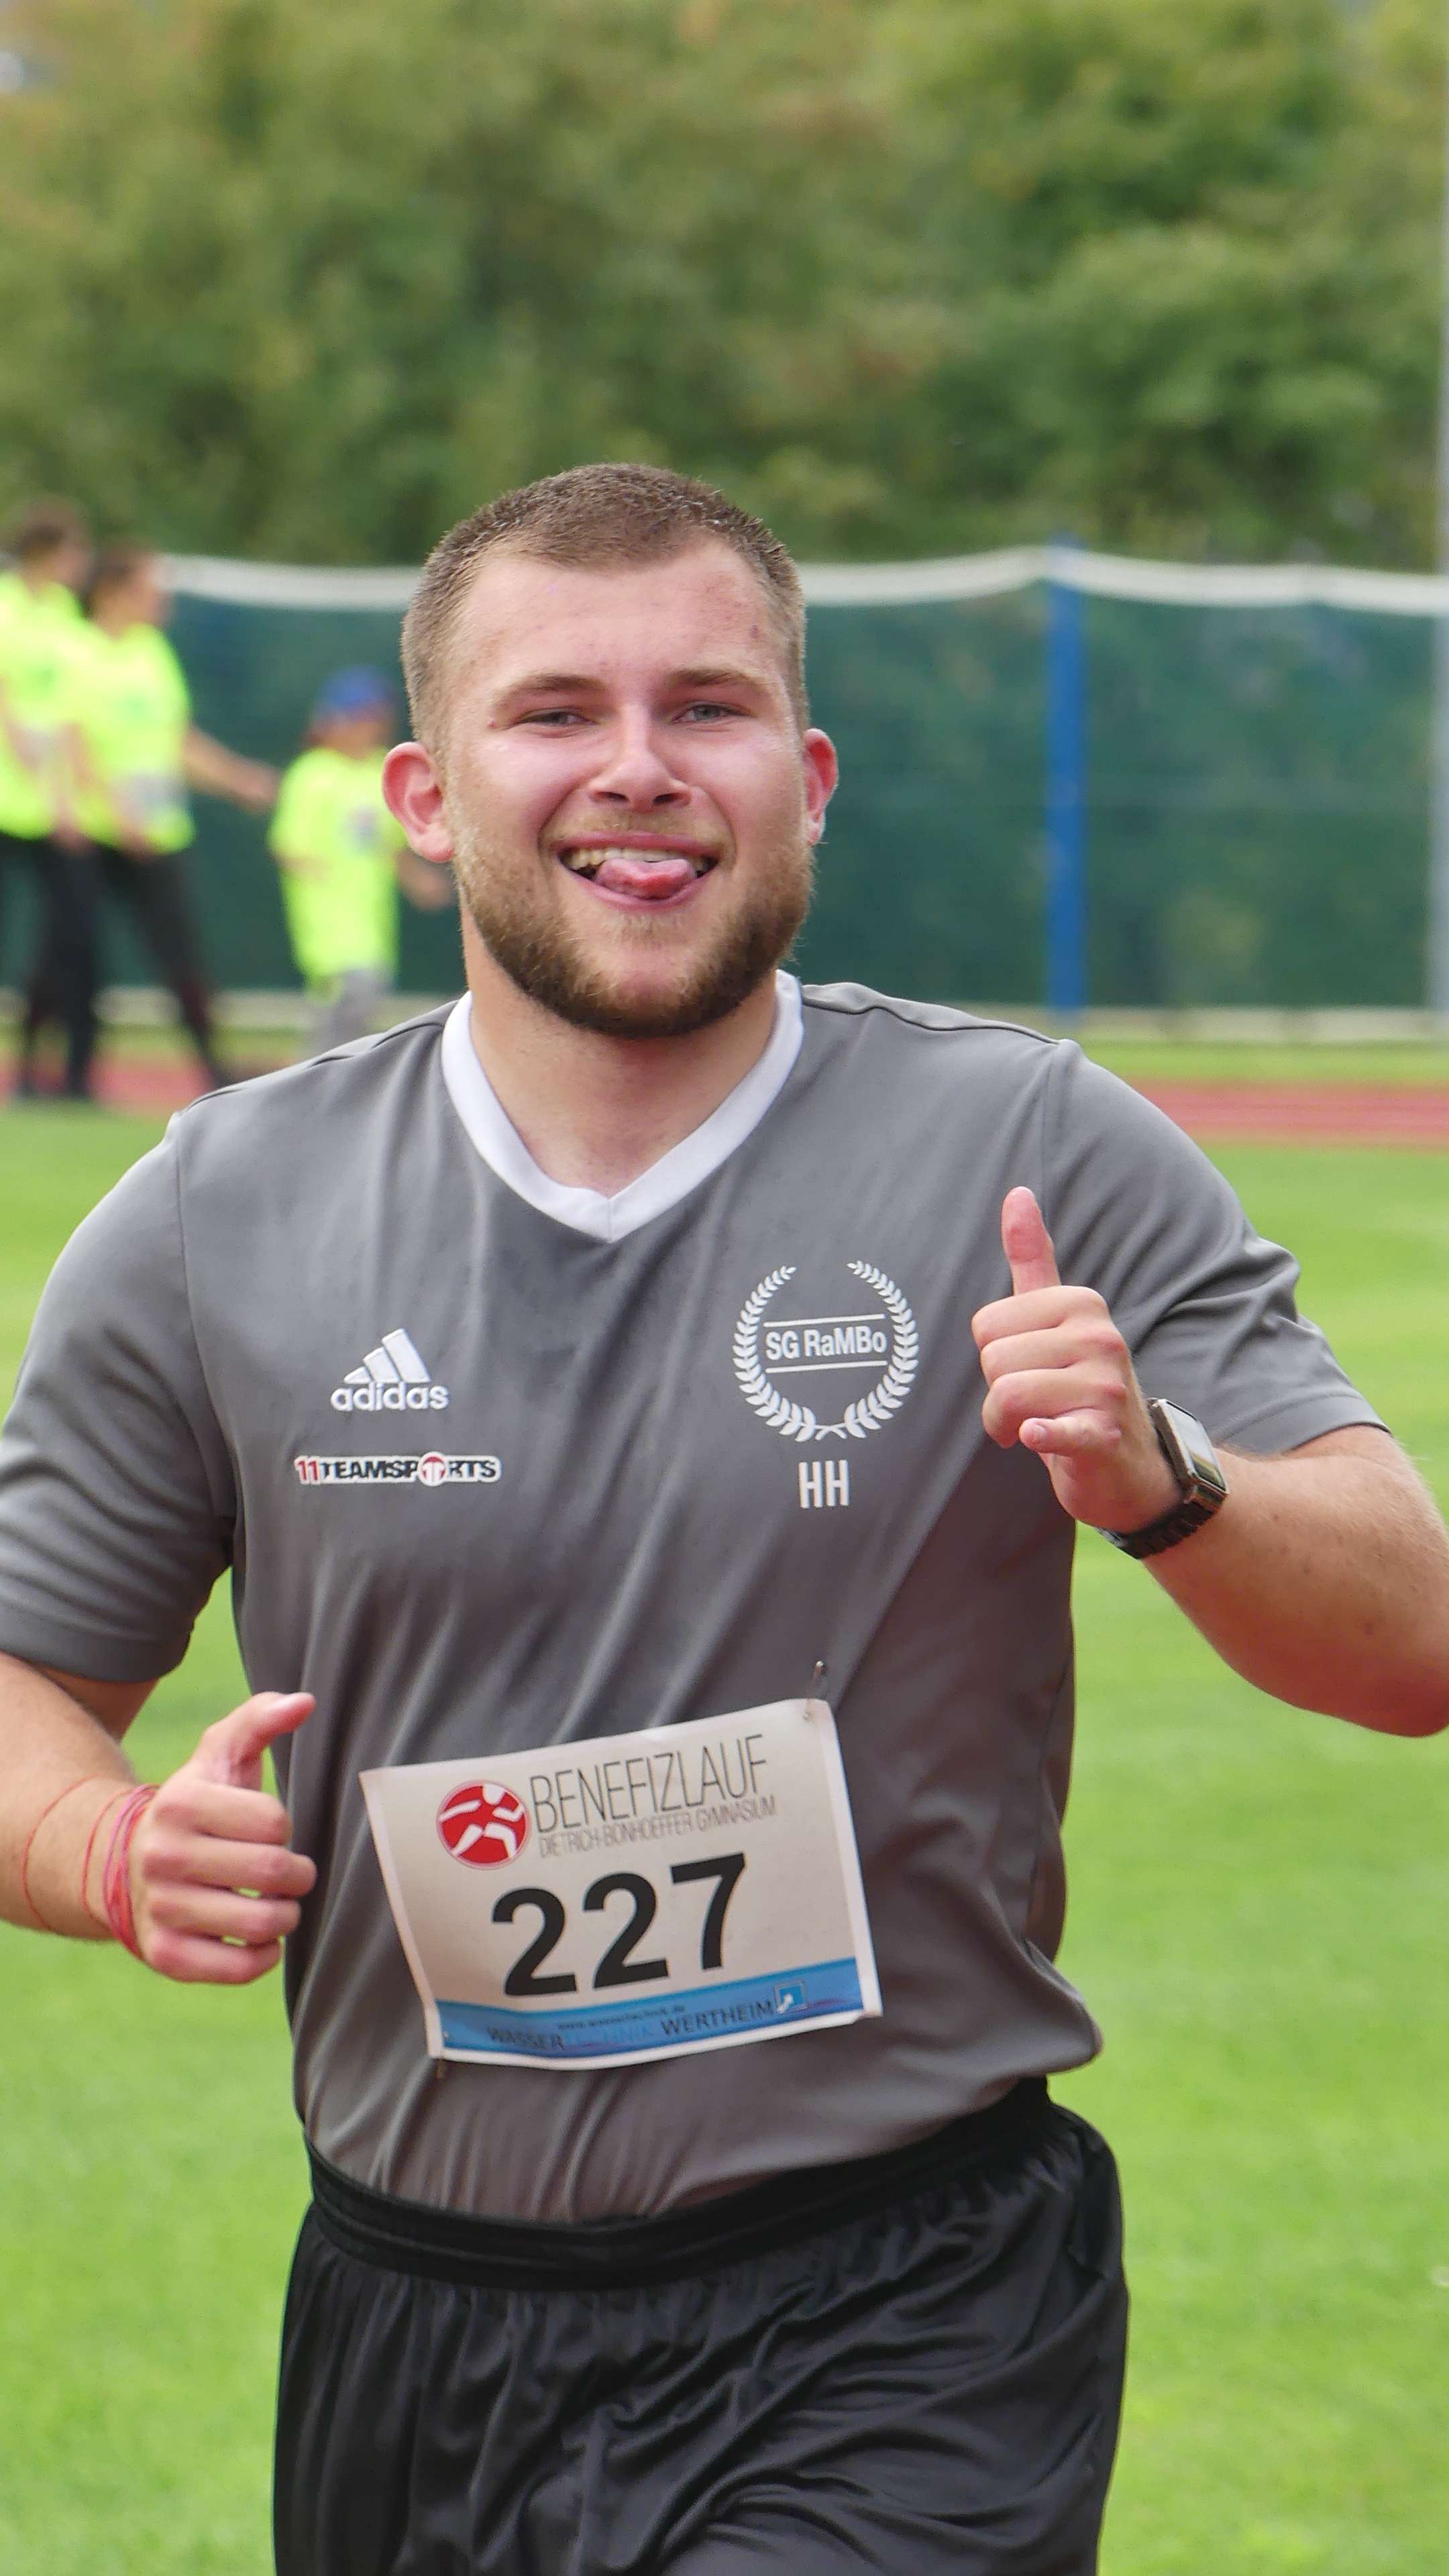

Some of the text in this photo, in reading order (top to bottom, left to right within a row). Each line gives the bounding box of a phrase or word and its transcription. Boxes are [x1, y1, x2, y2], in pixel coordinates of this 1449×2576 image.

[765, 1326, 887, 1361] SG RaMBo
[331, 1381, 449, 1411] adidas
[798, 1459, 849, 1509] HH
[529, 1734, 767, 1833] BENEFIZLAUF
[490, 1852, 745, 1997] 227
[661, 1999, 773, 2036] WERTHEIM
